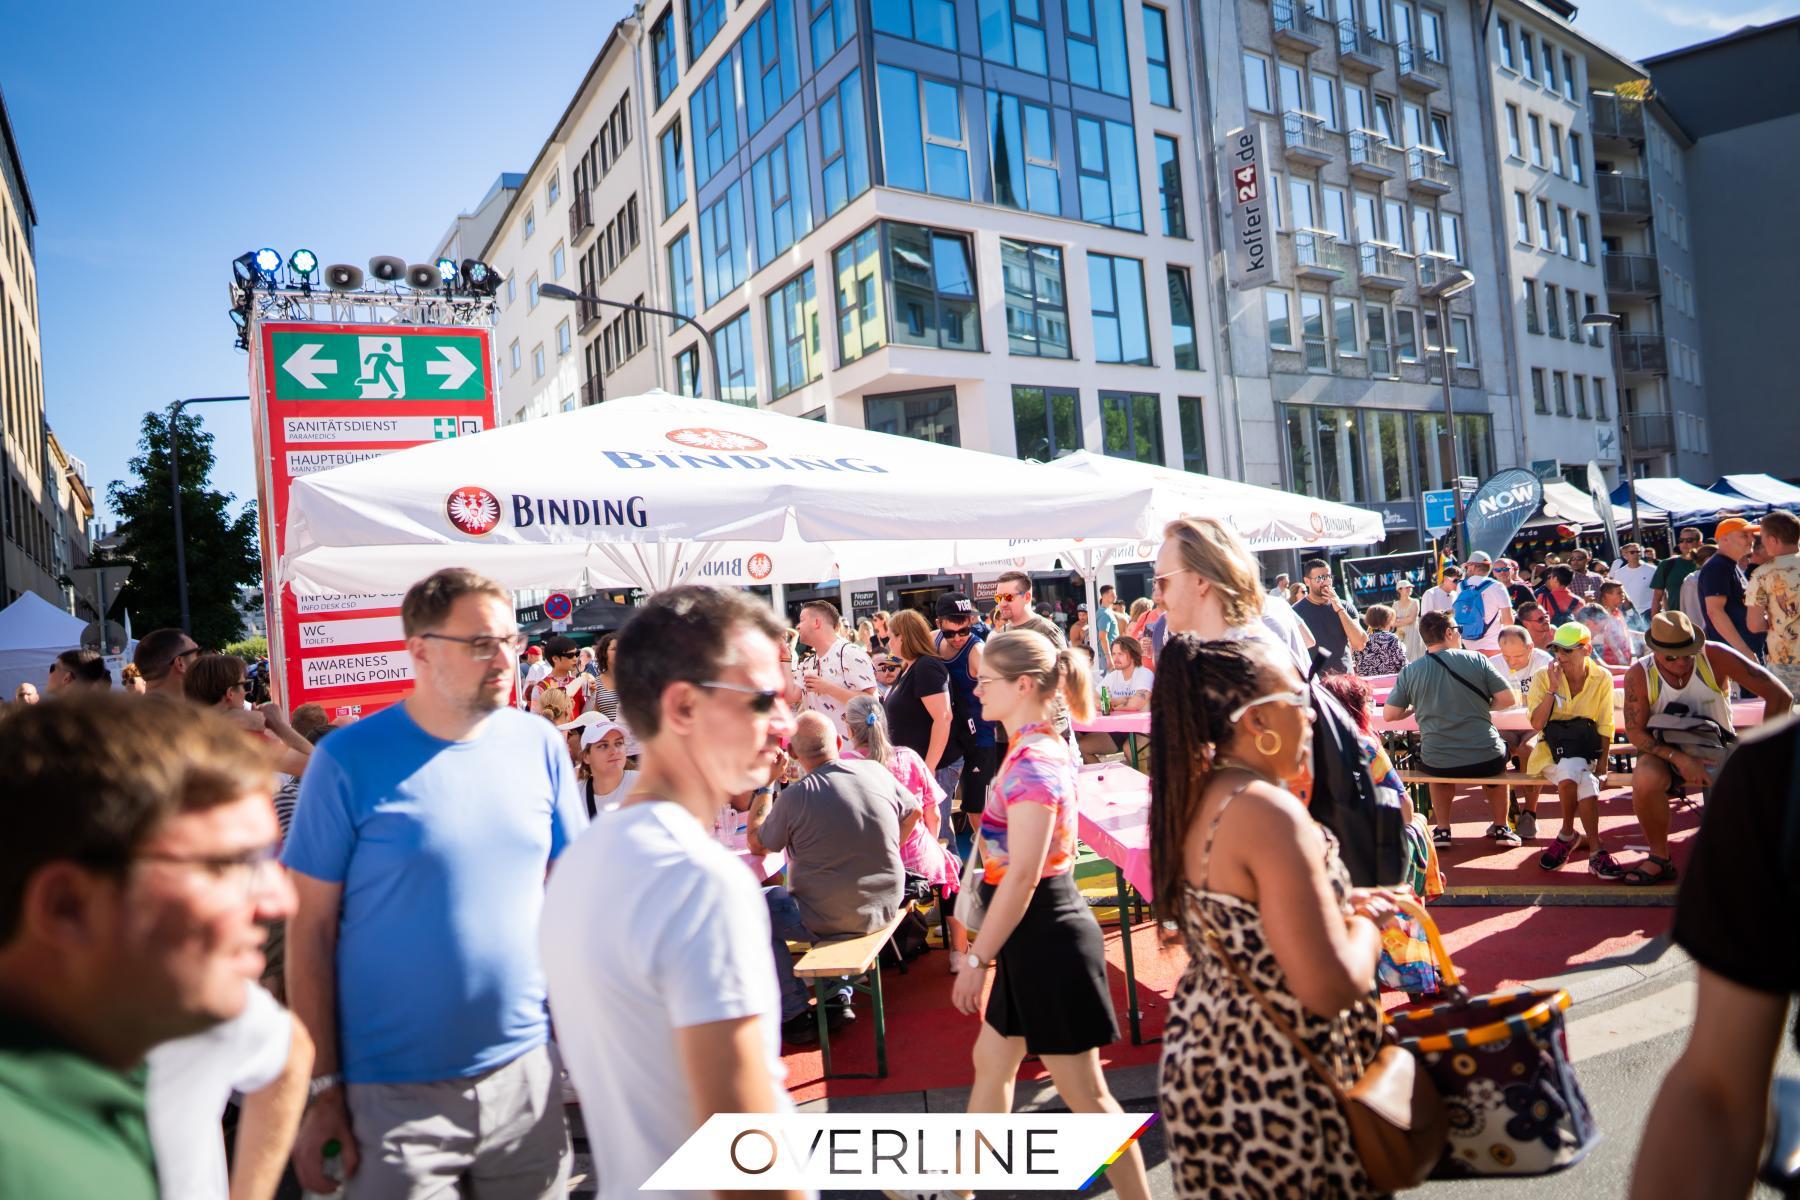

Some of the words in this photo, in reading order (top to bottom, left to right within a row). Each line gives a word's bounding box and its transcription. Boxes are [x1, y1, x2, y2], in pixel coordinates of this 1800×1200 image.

[1235, 133, 1265, 273] koffer24.de
[288, 419, 398, 432] SANITÄTSDIENST
[1479, 484, 1534, 515] NOW
[511, 494, 648, 528] BINDING
[1354, 574, 1376, 589] NOW
[1380, 570, 1401, 587] NOW
[1405, 568, 1425, 582] NOW
[303, 625, 326, 636] WC
[304, 637, 334, 645] TOILETS
[308, 655, 388, 672] AWARENESS
[309, 671, 366, 686] HELPING
[369, 668, 408, 681] POINT
